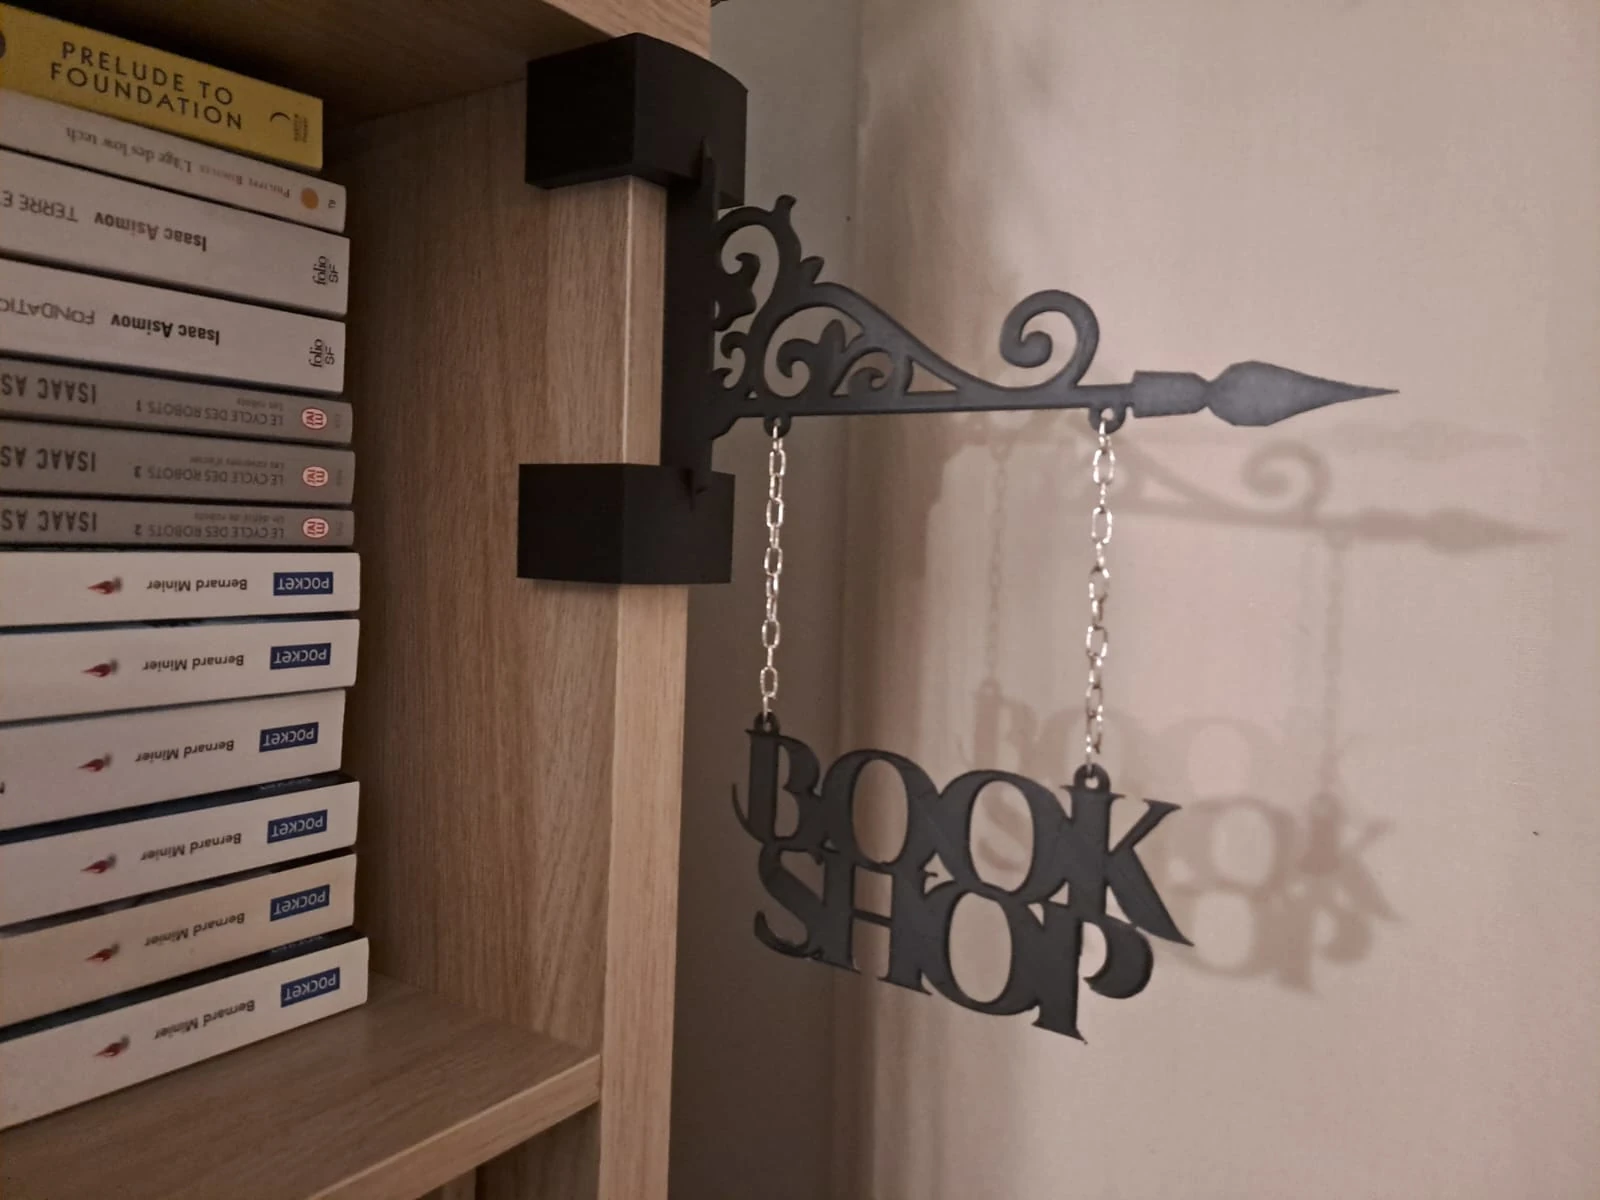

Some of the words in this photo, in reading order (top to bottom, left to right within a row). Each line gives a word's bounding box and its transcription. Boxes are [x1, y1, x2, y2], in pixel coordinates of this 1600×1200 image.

[61, 40, 185, 92] PRELUDE
[198, 81, 234, 106] TO
[50, 62, 243, 131] FOUNDATION
[66, 127, 98, 144] tech
[103, 138, 128, 157] low
[131, 145, 154, 163] des
[0, 190, 14, 208] E
[19, 193, 79, 223] TERRE
[94, 212, 158, 241] Asimov
[163, 228, 207, 252] Isaac
[312, 256, 327, 287] folio
[328, 264, 339, 284] SF
[110, 314, 173, 339] Asimov
[178, 325, 220, 346] Isaac
[308, 338, 323, 368] folio
[325, 346, 335, 366] SF
[37, 377, 97, 404] ISAAC
[136, 399, 142, 412] 1
[147, 401, 201, 418] ROBOTS
[204, 407, 228, 421] DES
[231, 410, 268, 425] CYCLE
[271, 414, 284, 426] LE
[37, 448, 97, 473] ISAAC
[134, 465, 142, 478] 3
[147, 465, 201, 481] ROBOTS
[204, 469, 228, 483] DES
[231, 471, 268, 485] CYCLE
[271, 474, 284, 486] LE
[37, 509, 97, 532] ISAAC
[134, 524, 142, 536] 2
[148, 524, 202, 538] ROBOTS
[205, 525, 228, 538] DES
[232, 526, 268, 539] CYCLE
[272, 527, 284, 539] LE
[147, 579, 191, 592] Minier
[196, 578, 248, 592] Bernard
[142, 659, 187, 672] Minier
[192, 655, 244, 671] Bernard
[135, 748, 179, 763] Minier
[183, 740, 235, 759] Bernard
[189, 833, 242, 854] Bernard
[732, 727, 1194, 947] BOOK
[141, 844, 186, 862] Minier
[193, 912, 245, 937] Bernard
[144, 927, 189, 947] Minier
[754, 841, 1154, 1044] SHOP
[203, 1000, 256, 1026] Bernard
[154, 1020, 199, 1040] Minier
